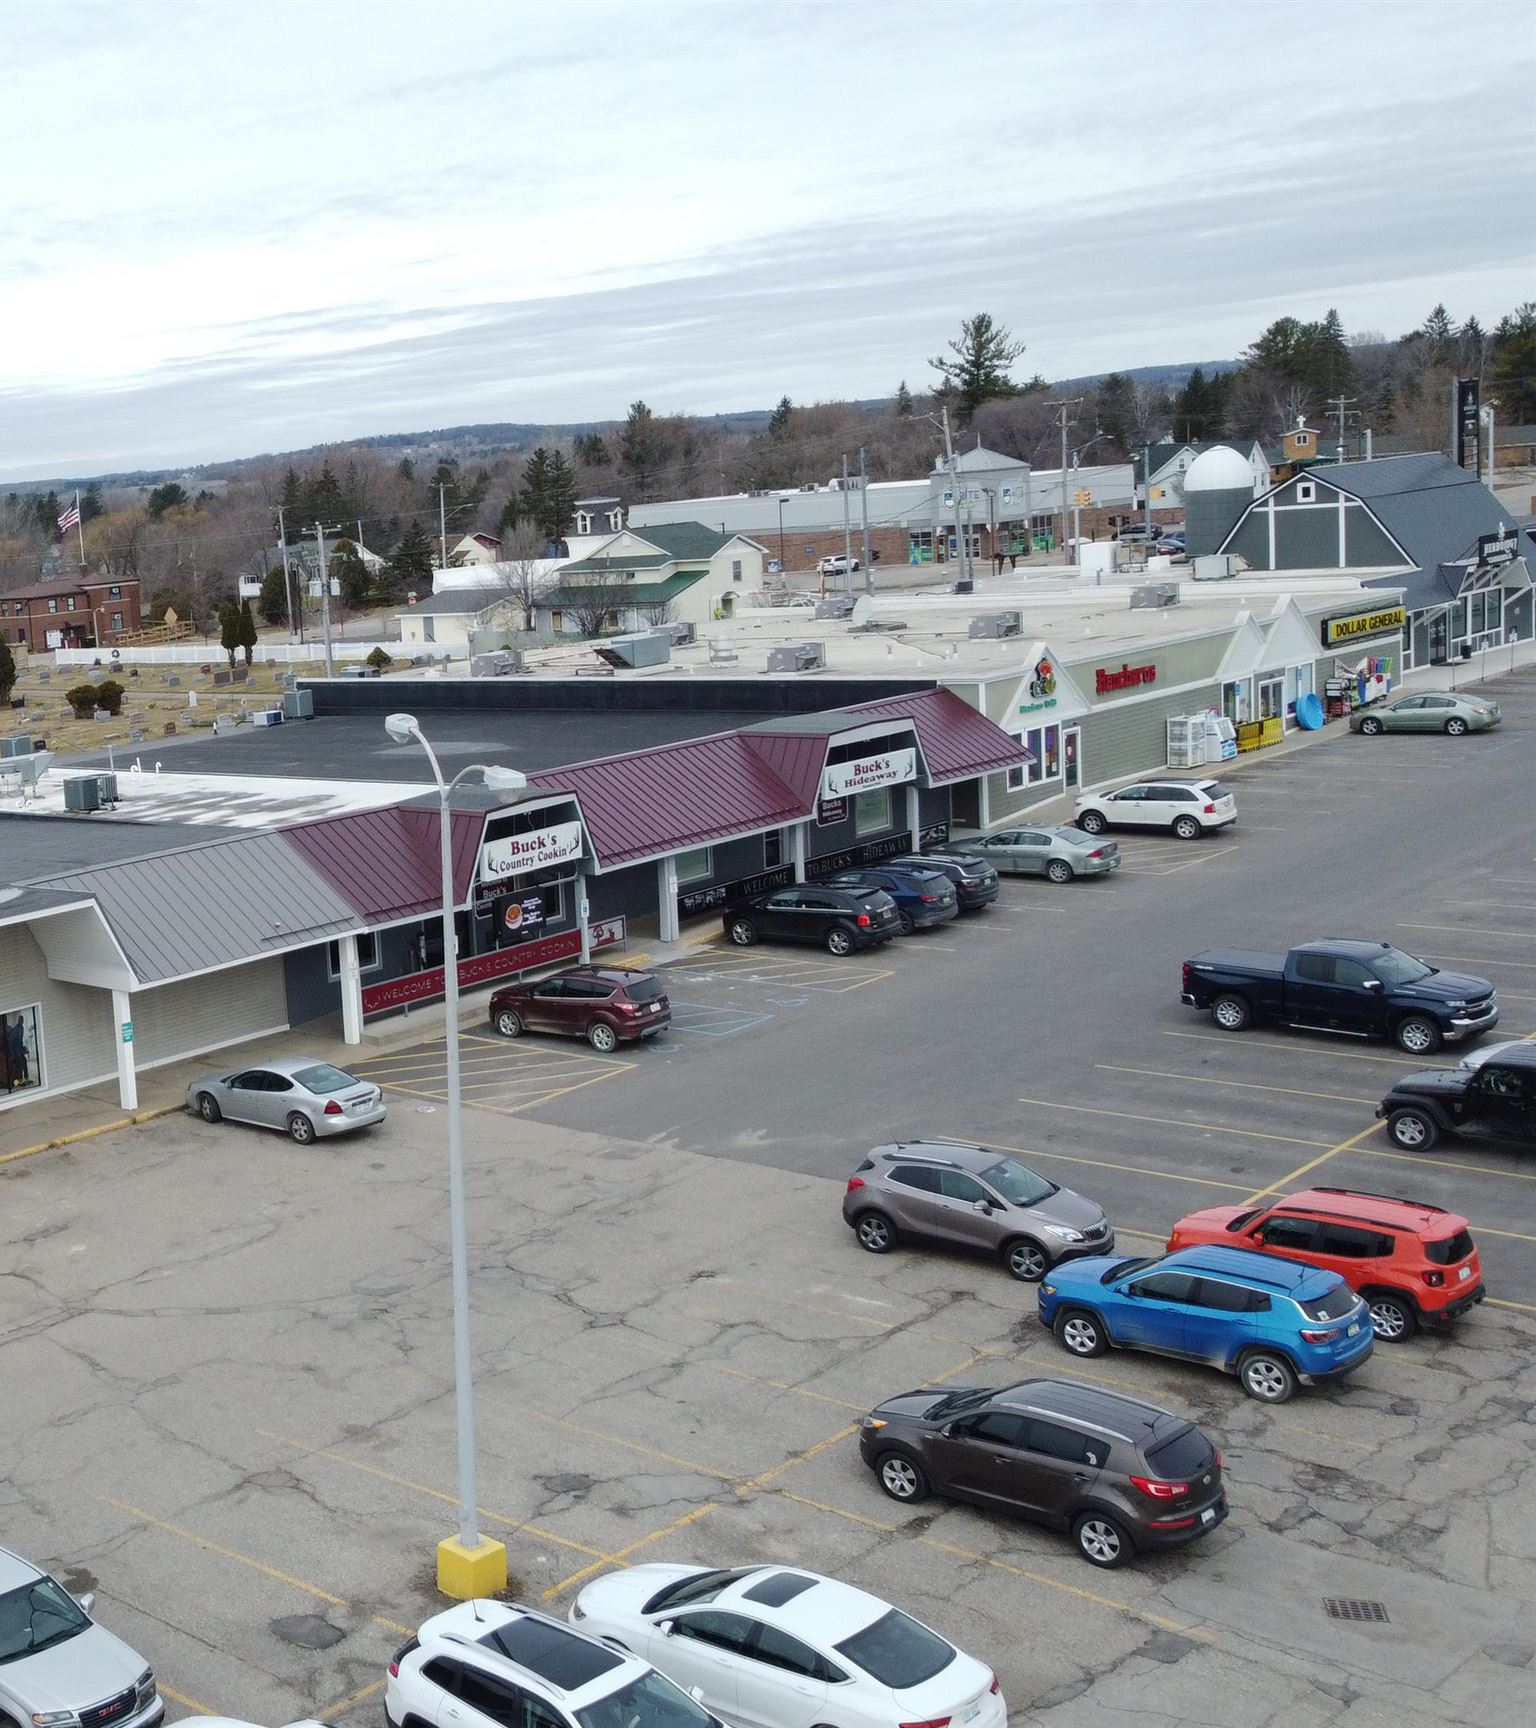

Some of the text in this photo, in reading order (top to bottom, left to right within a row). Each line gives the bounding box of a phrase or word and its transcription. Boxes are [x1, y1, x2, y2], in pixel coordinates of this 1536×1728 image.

[1336, 610, 1402, 637] DOLLAR GENERAL
[853, 759, 890, 776] Buck's
[844, 770, 898, 788] Hideaway
[510, 833, 558, 856] Buck's
[499, 855, 535, 873] Country
[381, 981, 432, 1001] WELCOME
[98, 1702, 121, 1717] GMC
